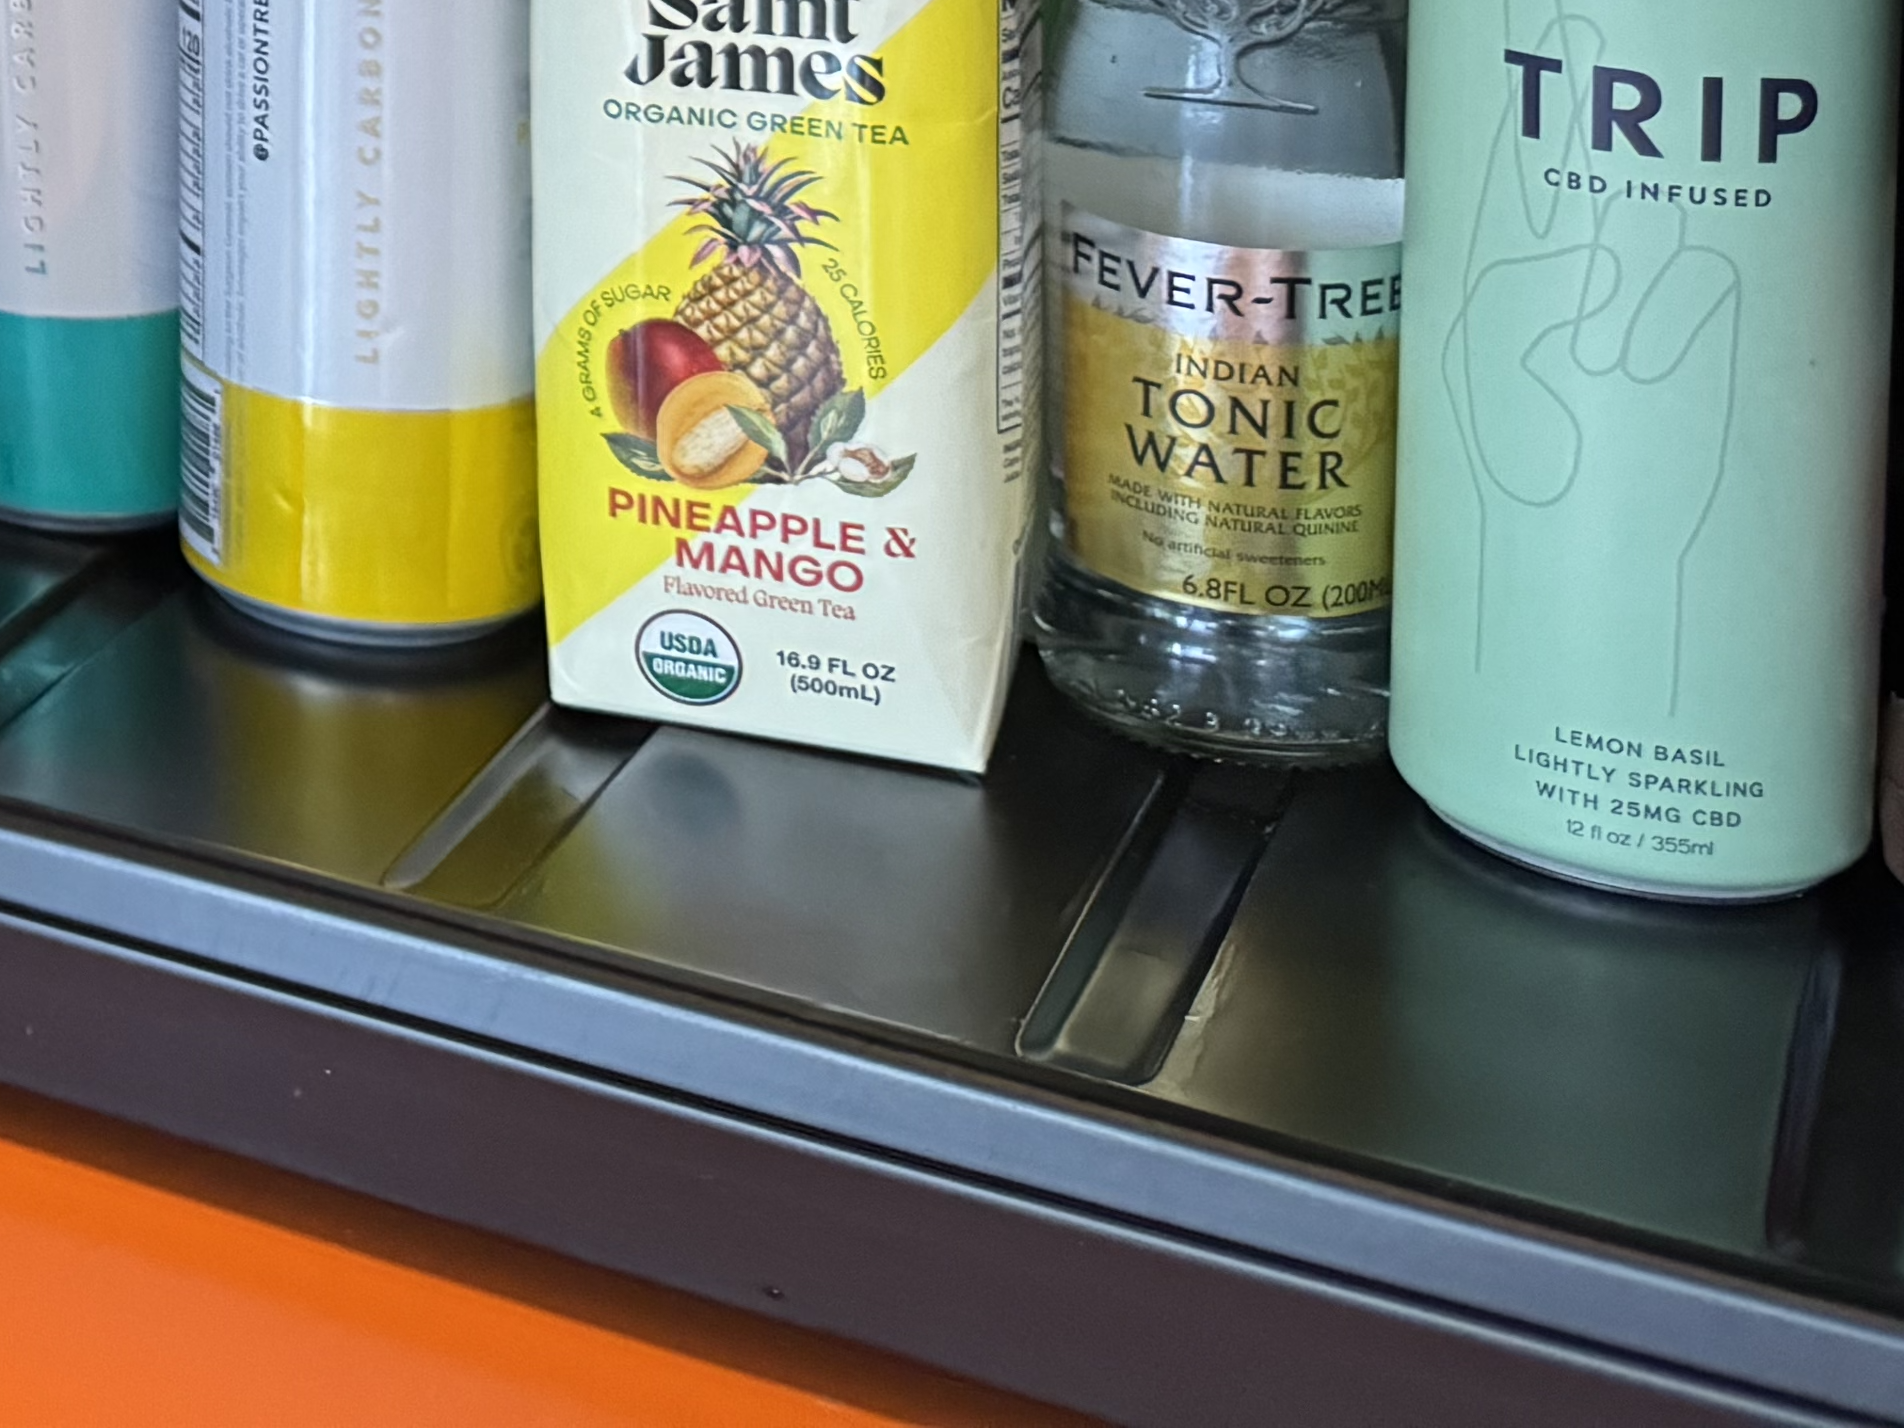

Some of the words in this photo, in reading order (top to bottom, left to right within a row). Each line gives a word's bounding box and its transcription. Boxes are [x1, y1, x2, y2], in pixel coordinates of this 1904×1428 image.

[623, 33, 886, 106] James
[603, 98, 739, 129] ORGANIC
[747, 110, 843, 140] GREEN
[852, 122, 910, 146] TEA
[1504, 49, 1818, 163] TRIP
[15, 114, 48, 278] LIGHTLY
[1544, 167, 1607, 194] CBD
[1626, 180, 1772, 207] INFUSED
[355, 189, 382, 366] LIGHTLY
[601, 283, 671, 308] SUGAR
[583, 299, 601, 327] OF
[822, 258, 847, 282] 25
[840, 283, 887, 381] CALORIES
[576, 327, 597, 403] GRAMS
[1175, 353, 1299, 387] INDIAN
[1131, 376, 1341, 440] TONIC
[1124, 423, 1349, 491] WATER
[1108, 474, 1149, 497] MADE
[1157, 490, 1201, 510] WITH
[1208, 500, 1288, 520] NATURAL
[1295, 504, 1362, 521] FLAVORS
[1110, 490, 1199, 525] INCLUDING
[1205, 516, 1285, 536] NATURAL
[1293, 520, 1360, 537] QUININE
[608, 487, 866, 555] PINEAPPLE
[883, 526, 917, 559] &
[675, 537, 864, 592] MANGO
[1168, 537, 1230, 560] artificial
[1236, 551, 1326, 566] sweeteners
[663, 575, 748, 604] Flavored
[753, 590, 813, 615] Green
[818, 598, 856, 621] Tea
[1182, 575, 1255, 606] 6.8FL
[1265, 585, 1312, 607] OZ
[1322, 578, 1389, 611] (200M
[659, 630, 718, 658] USDA
[776, 650, 821, 671] 16.9
[827, 658, 856, 677] FL
[862, 662, 896, 682] OZ
[652, 658, 727, 684] ORGANIC
[791, 673, 881, 706] (500mL)
[1555, 726, 1642, 758] LEMON
[1654, 745, 1726, 767] BASIL
[1514, 744, 1616, 783] LIGHTLY
[1628, 772, 1764, 797] SPARKLING
[1536, 780, 1598, 810] WITH
[1610, 798, 1681, 823] 25MG
[1692, 809, 1741, 828] CBD
[1566, 819, 1584, 837] 12
[1590, 825, 1602, 840] fl
[1607, 832, 1631, 846] oz
[1651, 835, 1714, 855] 355ml
